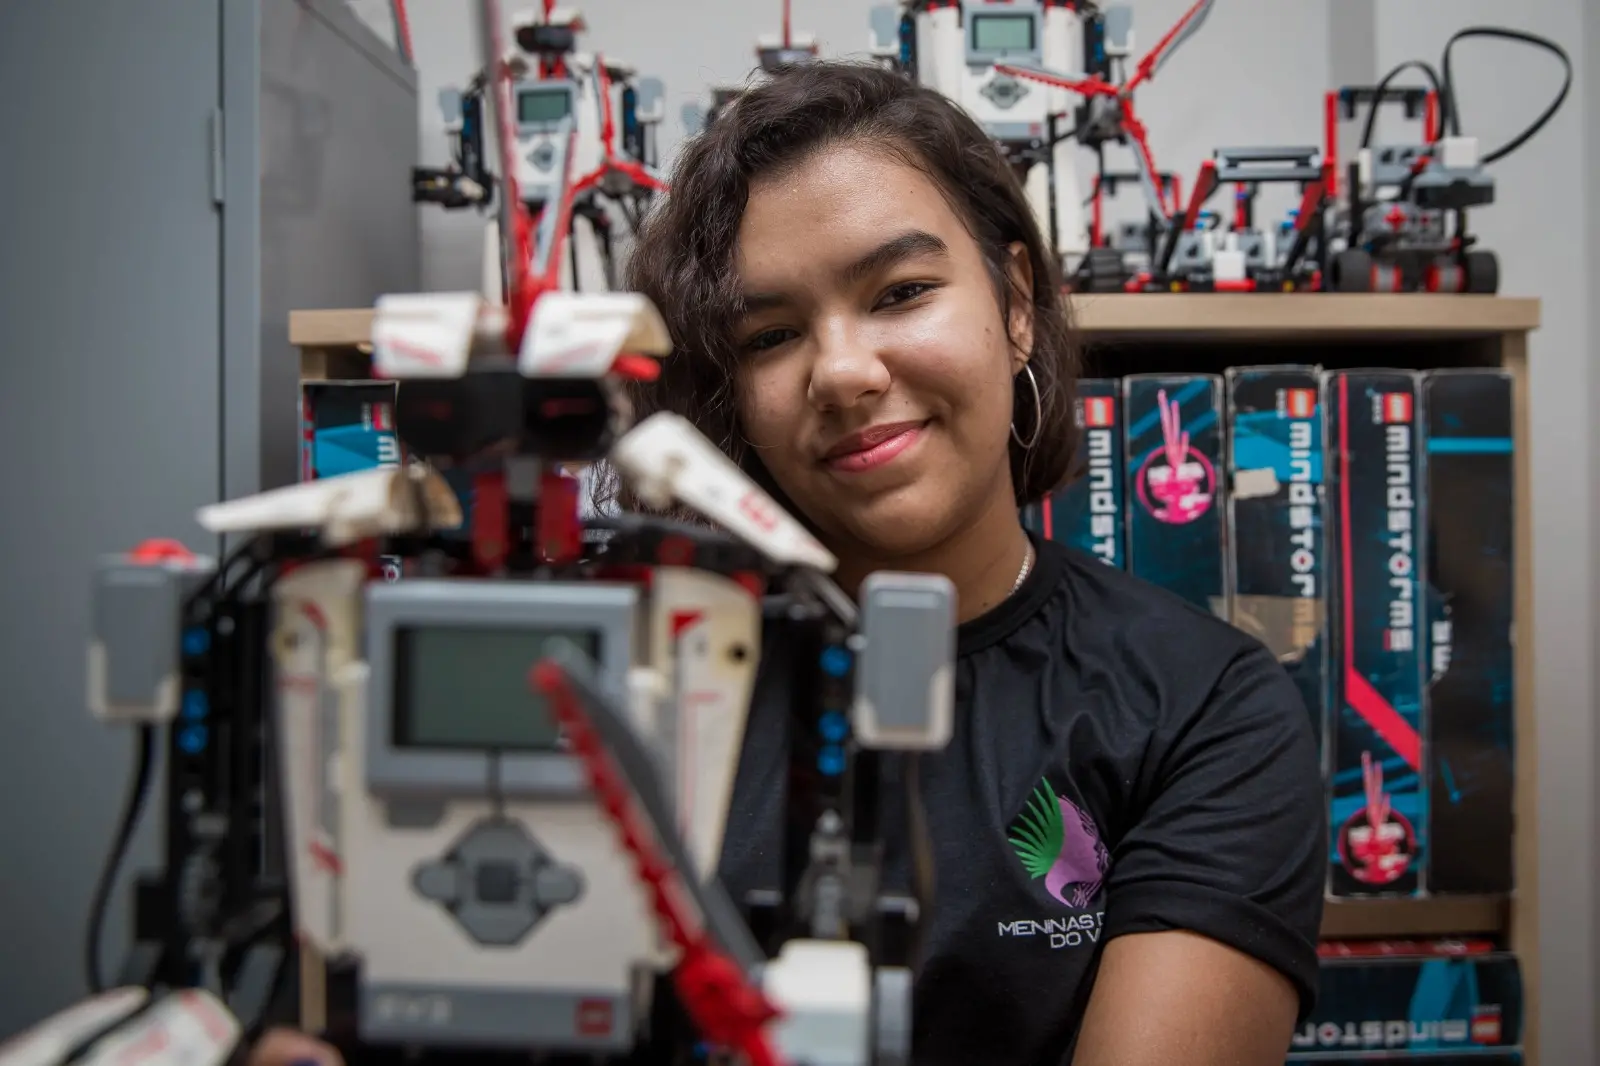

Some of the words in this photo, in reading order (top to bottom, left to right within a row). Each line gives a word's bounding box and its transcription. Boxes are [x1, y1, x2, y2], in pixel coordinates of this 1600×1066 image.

[1088, 429, 1117, 566] mindst
[998, 914, 1095, 936] MENINAS
[1050, 931, 1082, 949] DO
